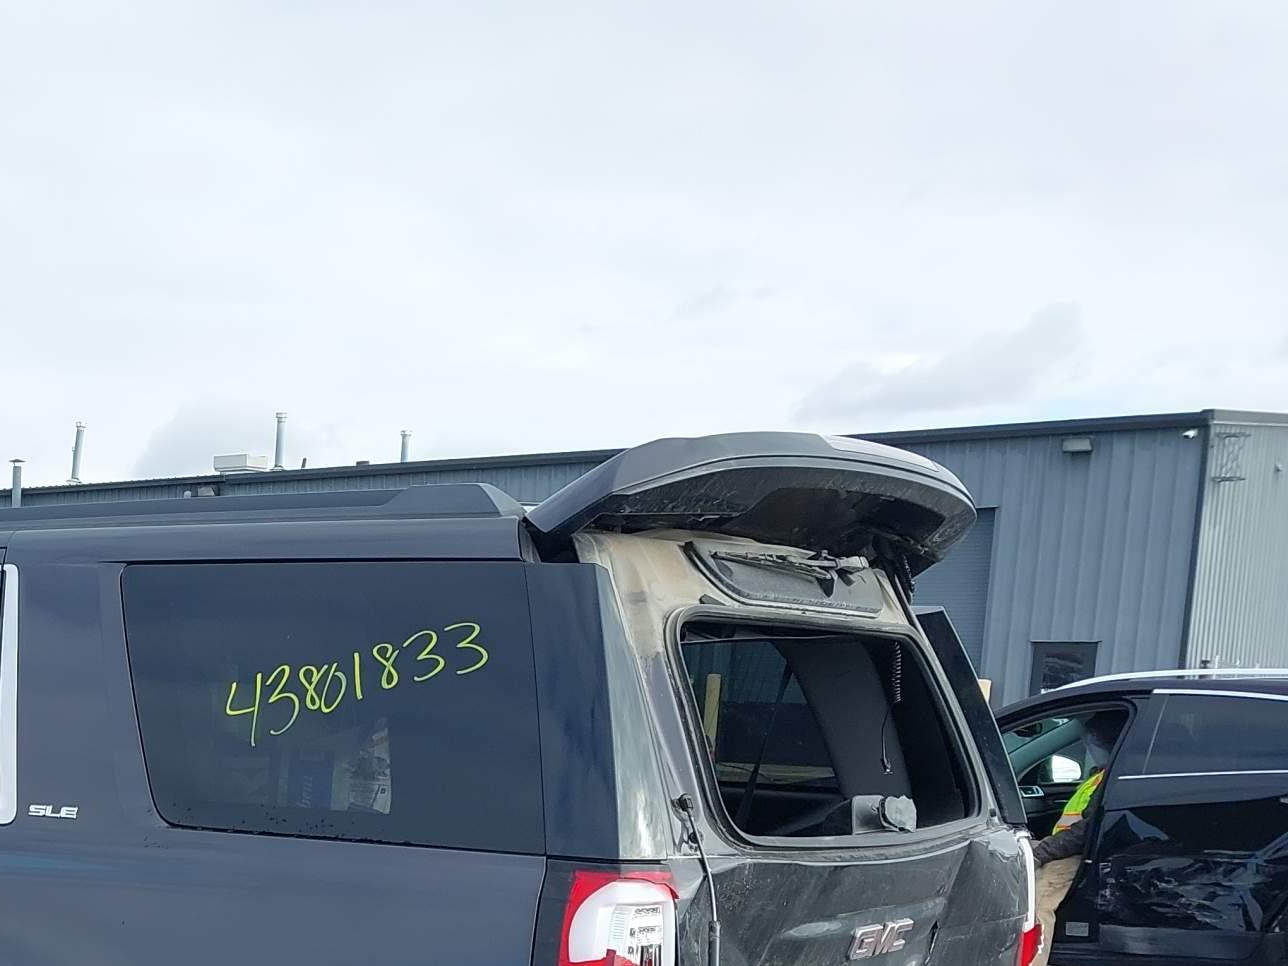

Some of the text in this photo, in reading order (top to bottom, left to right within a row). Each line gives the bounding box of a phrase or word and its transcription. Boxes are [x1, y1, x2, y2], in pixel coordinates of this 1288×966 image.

[225, 621, 490, 748] 43801833
[28, 804, 79, 819] SLE
[849, 917, 915, 961] GMC
